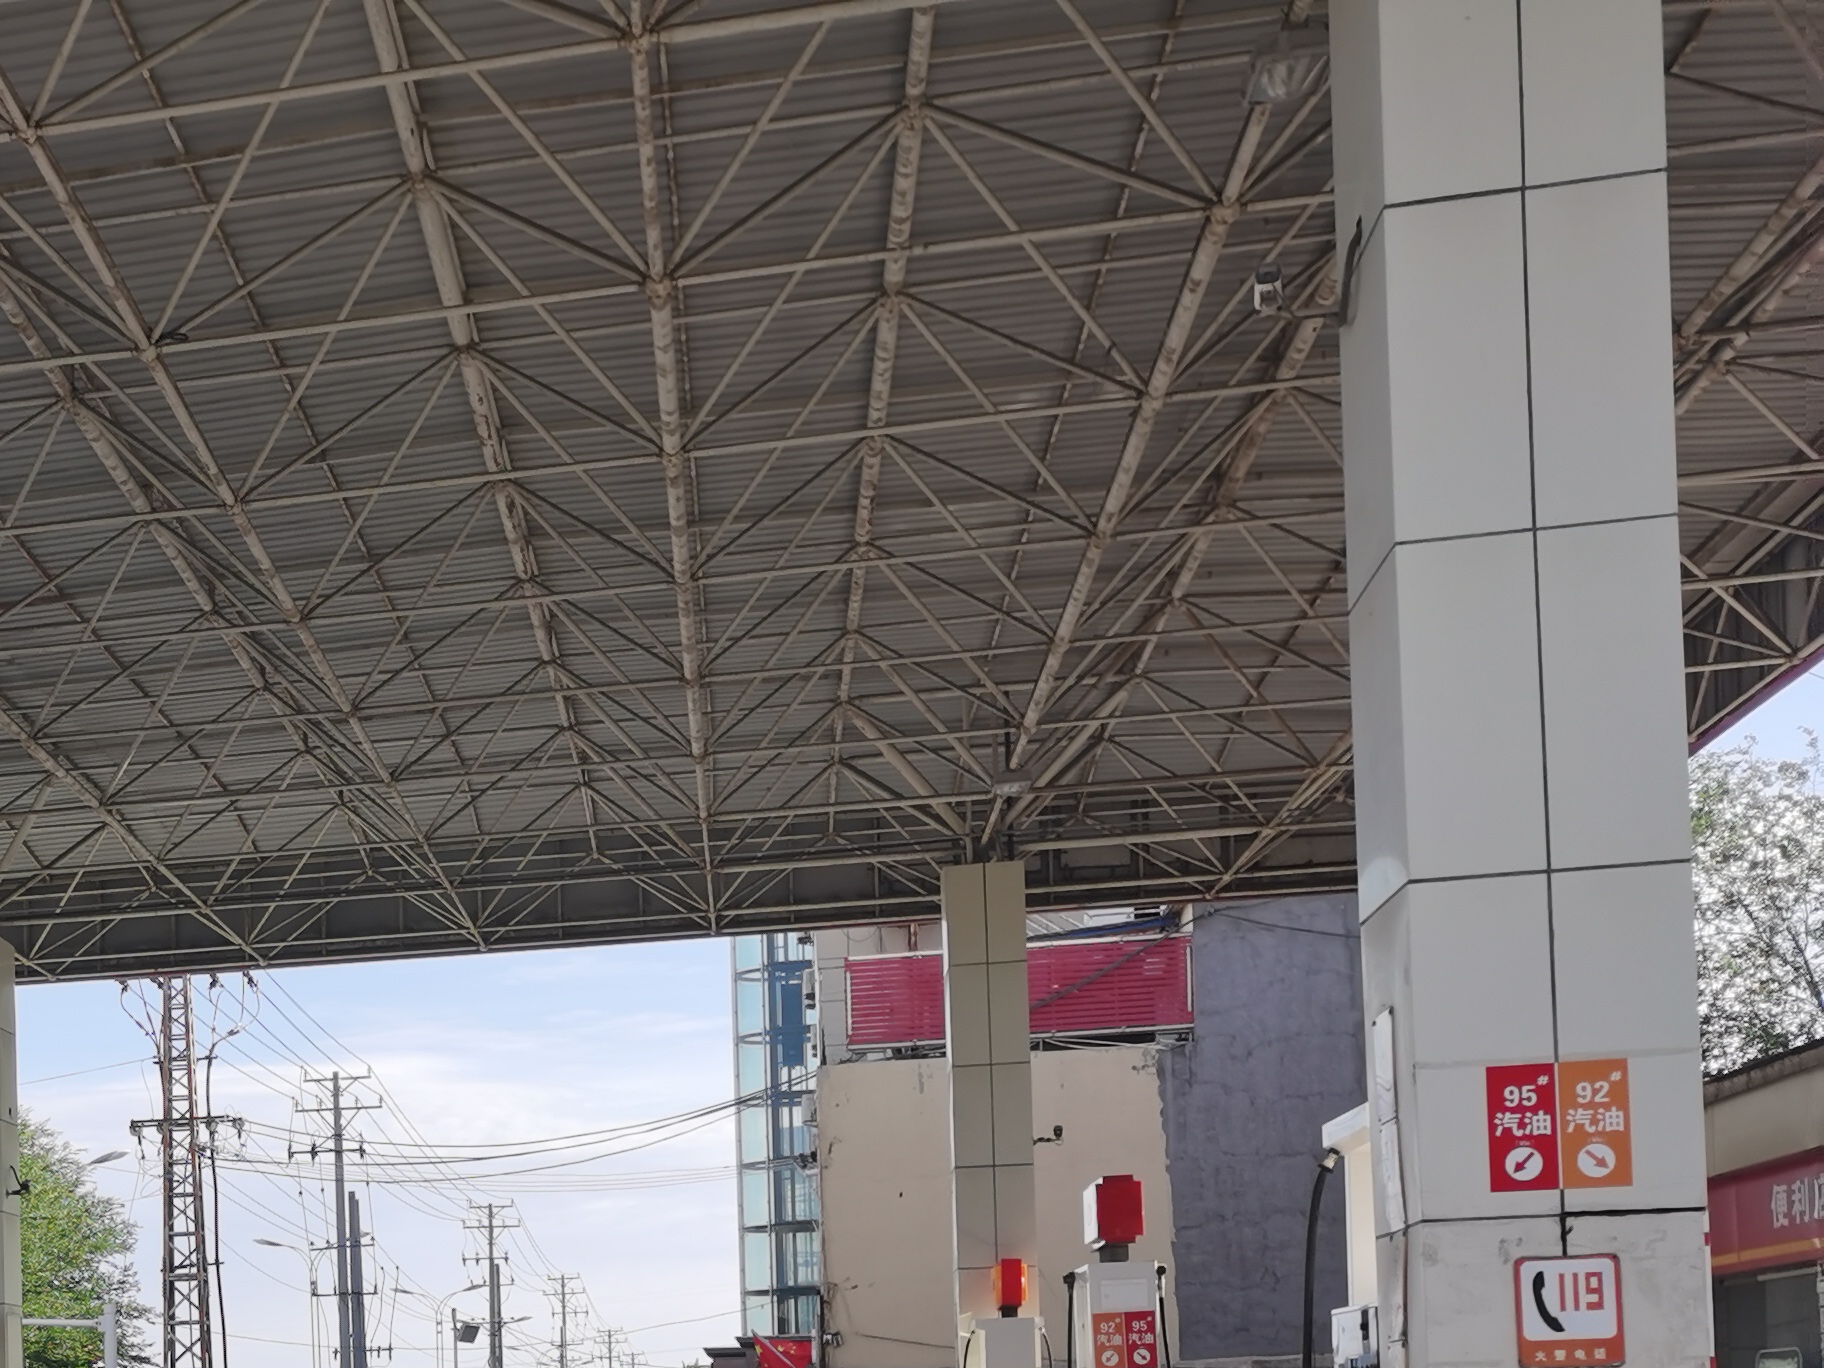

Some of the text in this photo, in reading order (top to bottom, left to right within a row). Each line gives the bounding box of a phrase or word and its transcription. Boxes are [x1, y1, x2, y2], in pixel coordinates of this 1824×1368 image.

[1503, 1074, 1549, 1107] 95#
[1575, 1071, 1623, 1104] 92#
[1493, 1109, 1553, 1138] 汽油
[1566, 1106, 1625, 1134] 汽油
[1771, 1172, 1824, 1229] 便利店
[1558, 1271, 1605, 1312] 119
[1096, 1333, 1123, 1346] 汽油
[1128, 1332, 1154, 1345] 汽油
